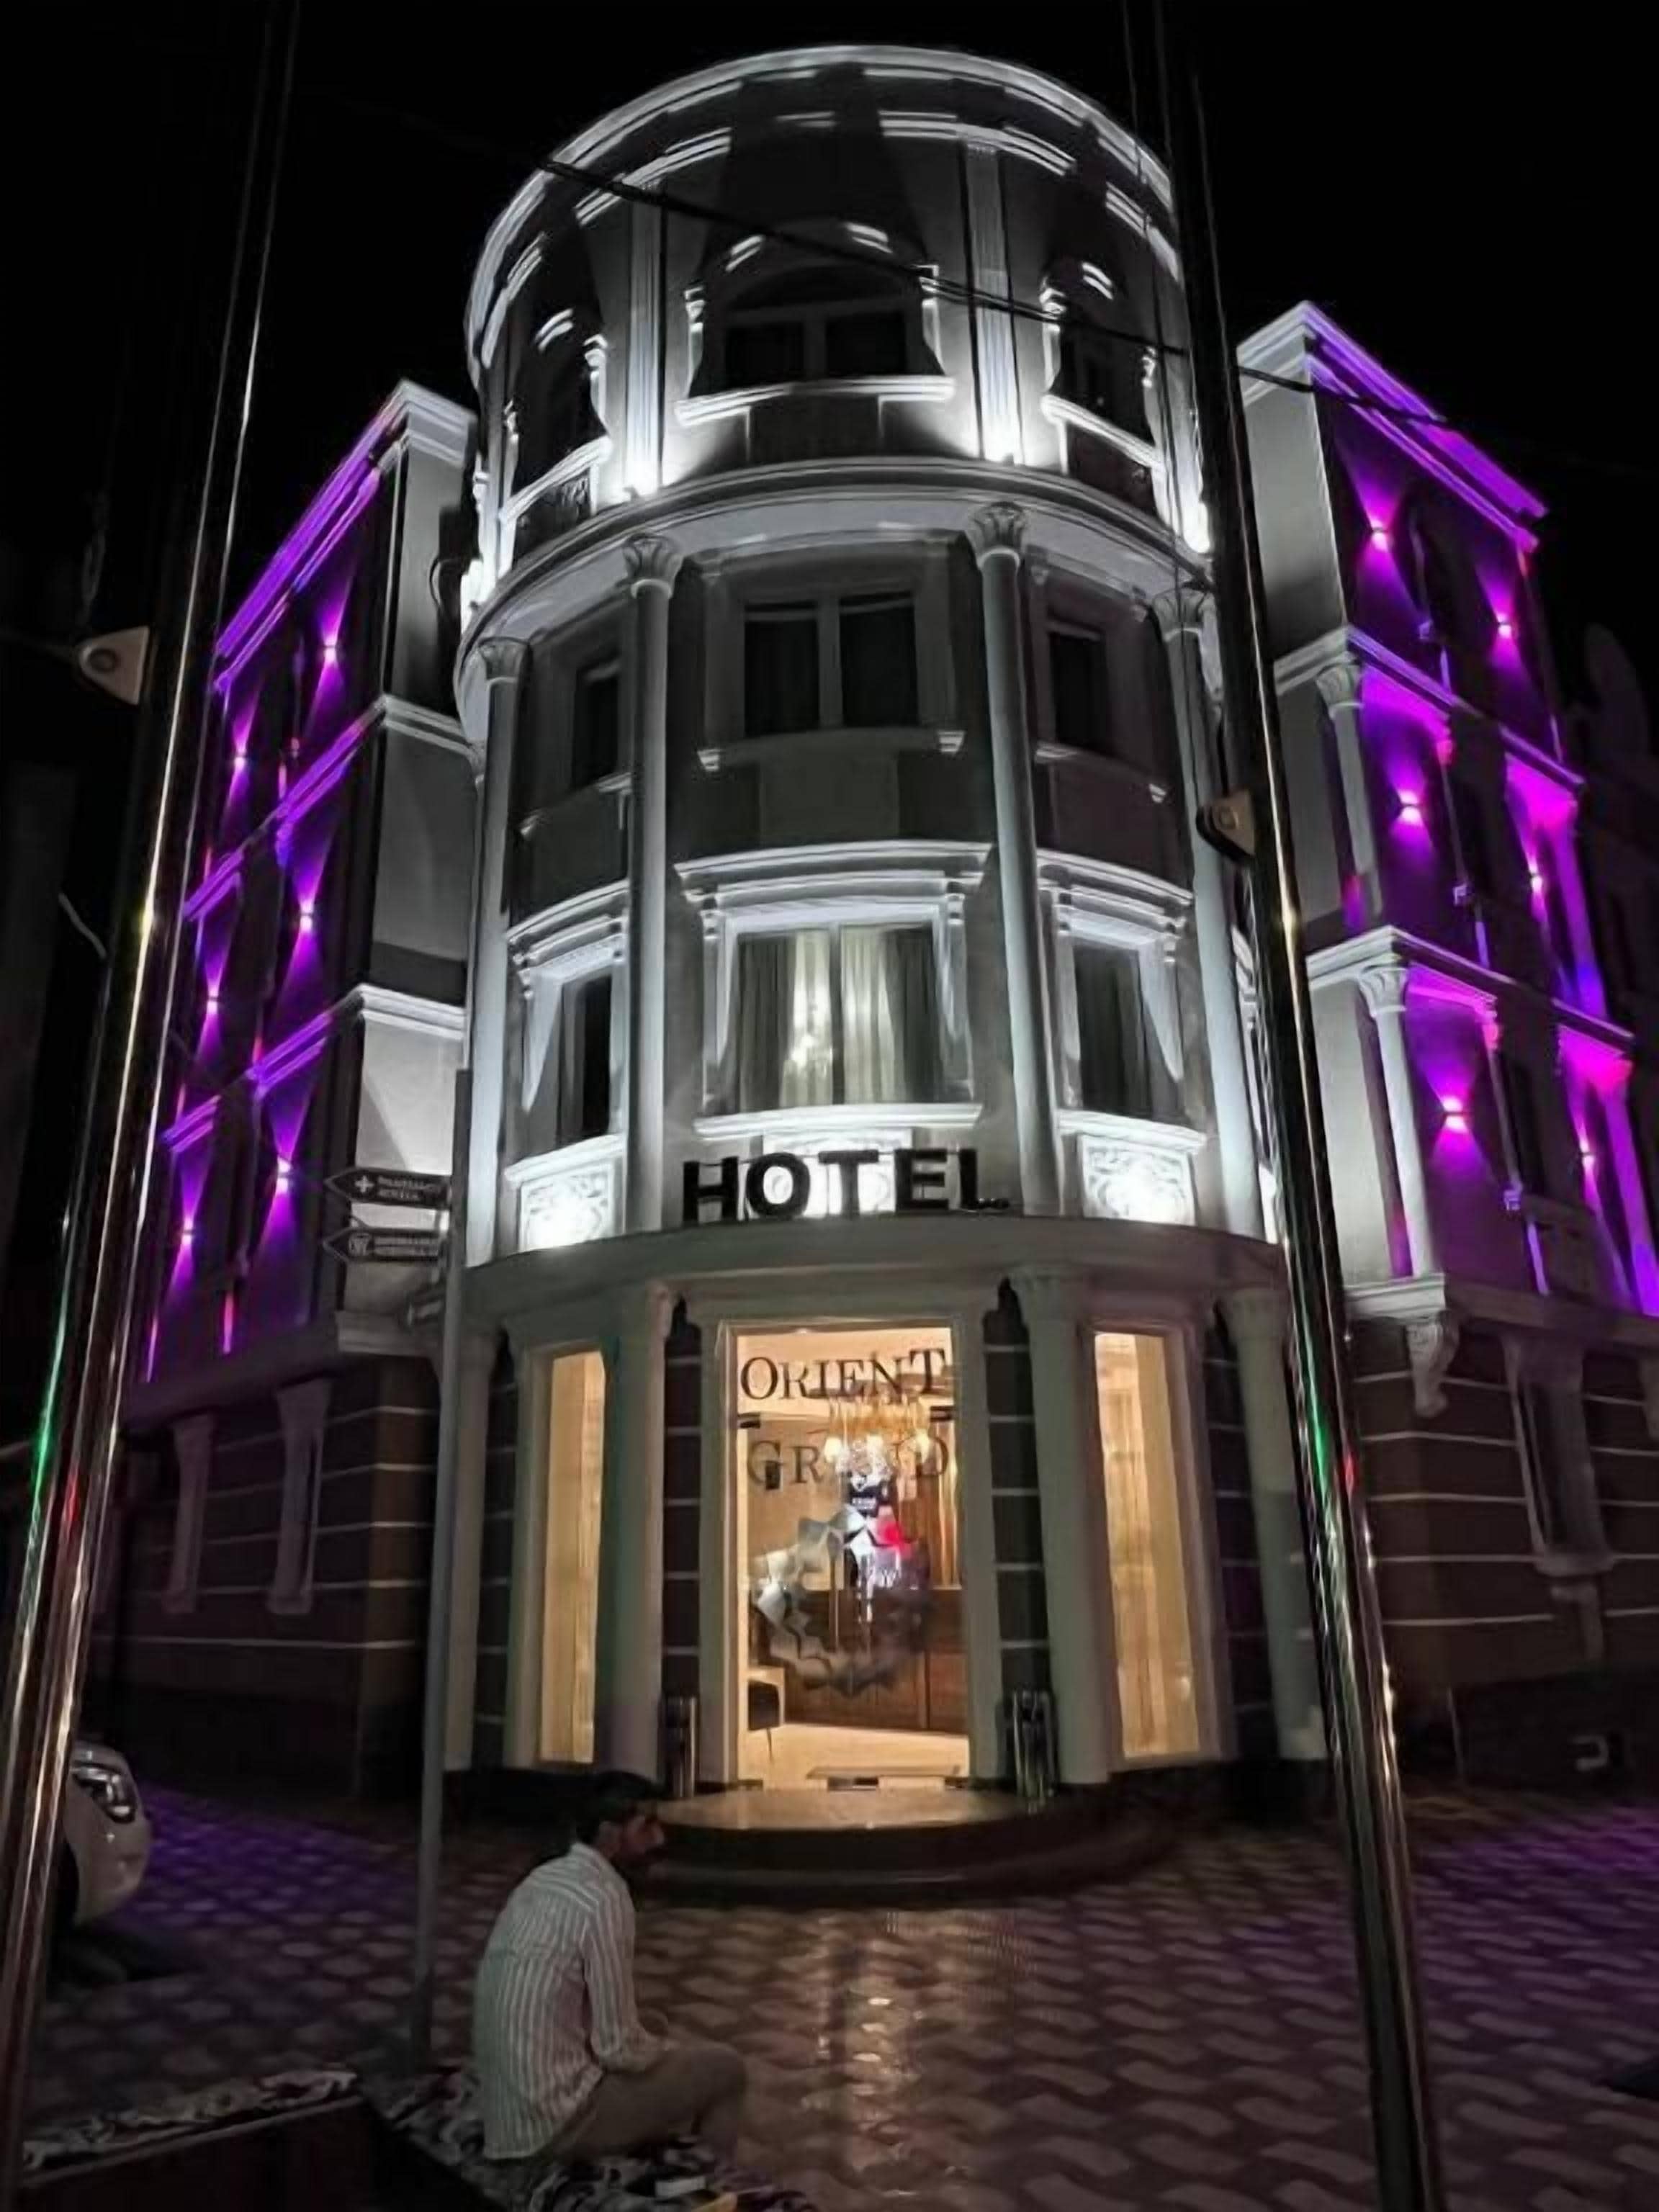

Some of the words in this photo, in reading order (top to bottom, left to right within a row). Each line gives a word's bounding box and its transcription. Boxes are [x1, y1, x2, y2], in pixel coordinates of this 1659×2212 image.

[683, 1148, 1010, 1227] HOTEL
[739, 1347, 946, 1404] ORIENT
[747, 1436, 950, 1485] GRD
